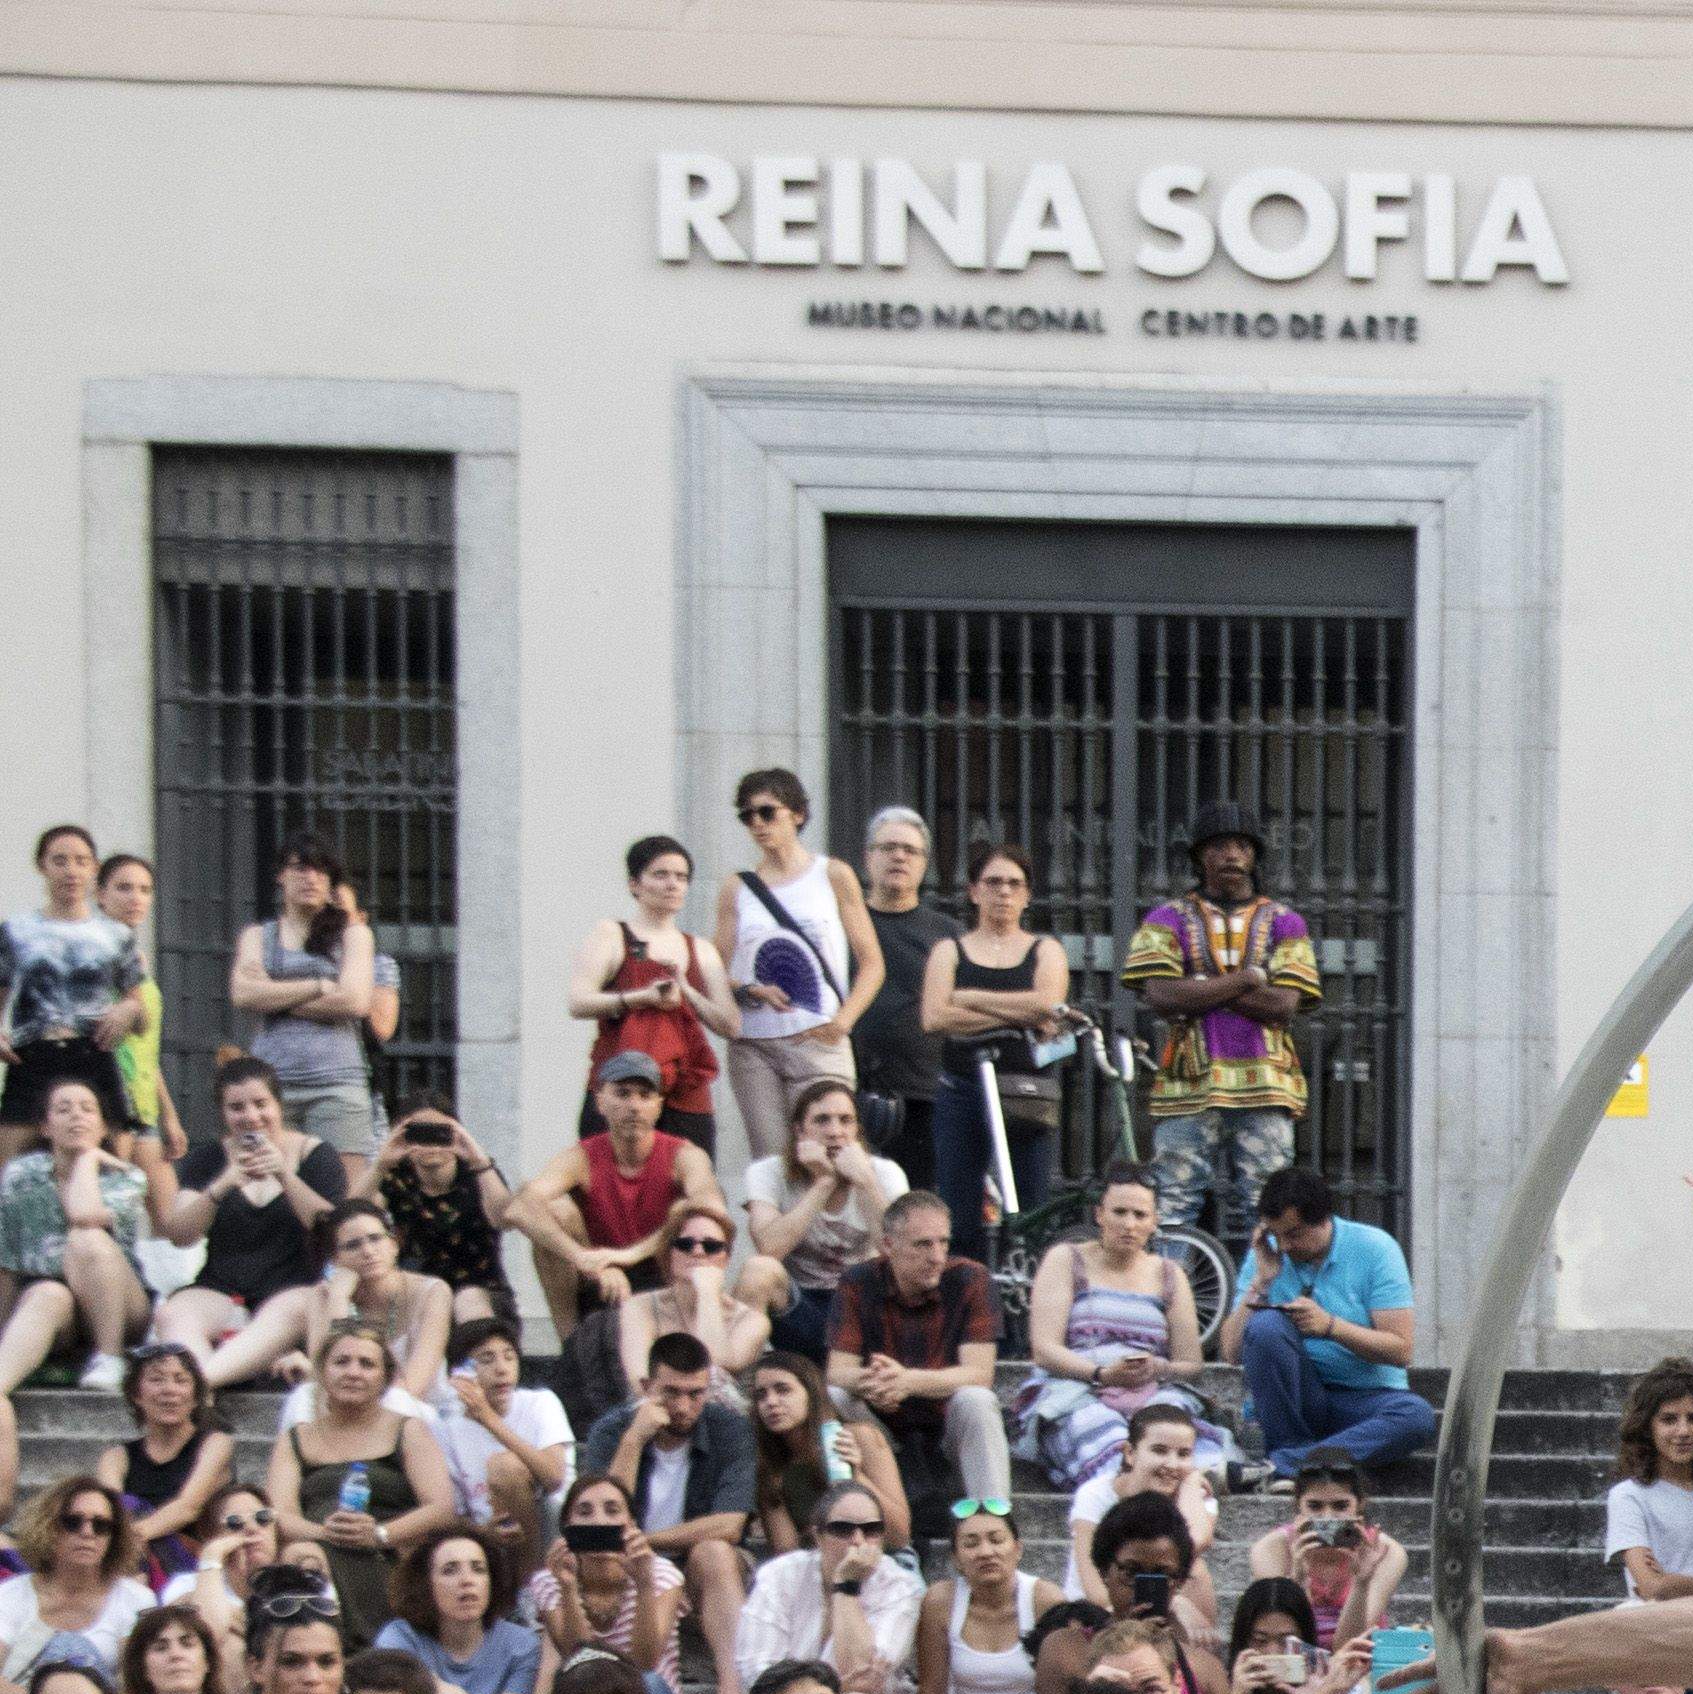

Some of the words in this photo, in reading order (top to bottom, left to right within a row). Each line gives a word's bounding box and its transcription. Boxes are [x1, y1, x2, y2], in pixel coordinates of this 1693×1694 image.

[657, 152, 1104, 275] REINA
[1135, 166, 1569, 286] SOFIA
[807, 301, 920, 328] MUSEO
[933, 304, 1107, 335] NACIONAL
[1140, 309, 1278, 339] CENTRO
[1288, 313, 1324, 341] DE
[1338, 315, 1417, 343] ARTE
